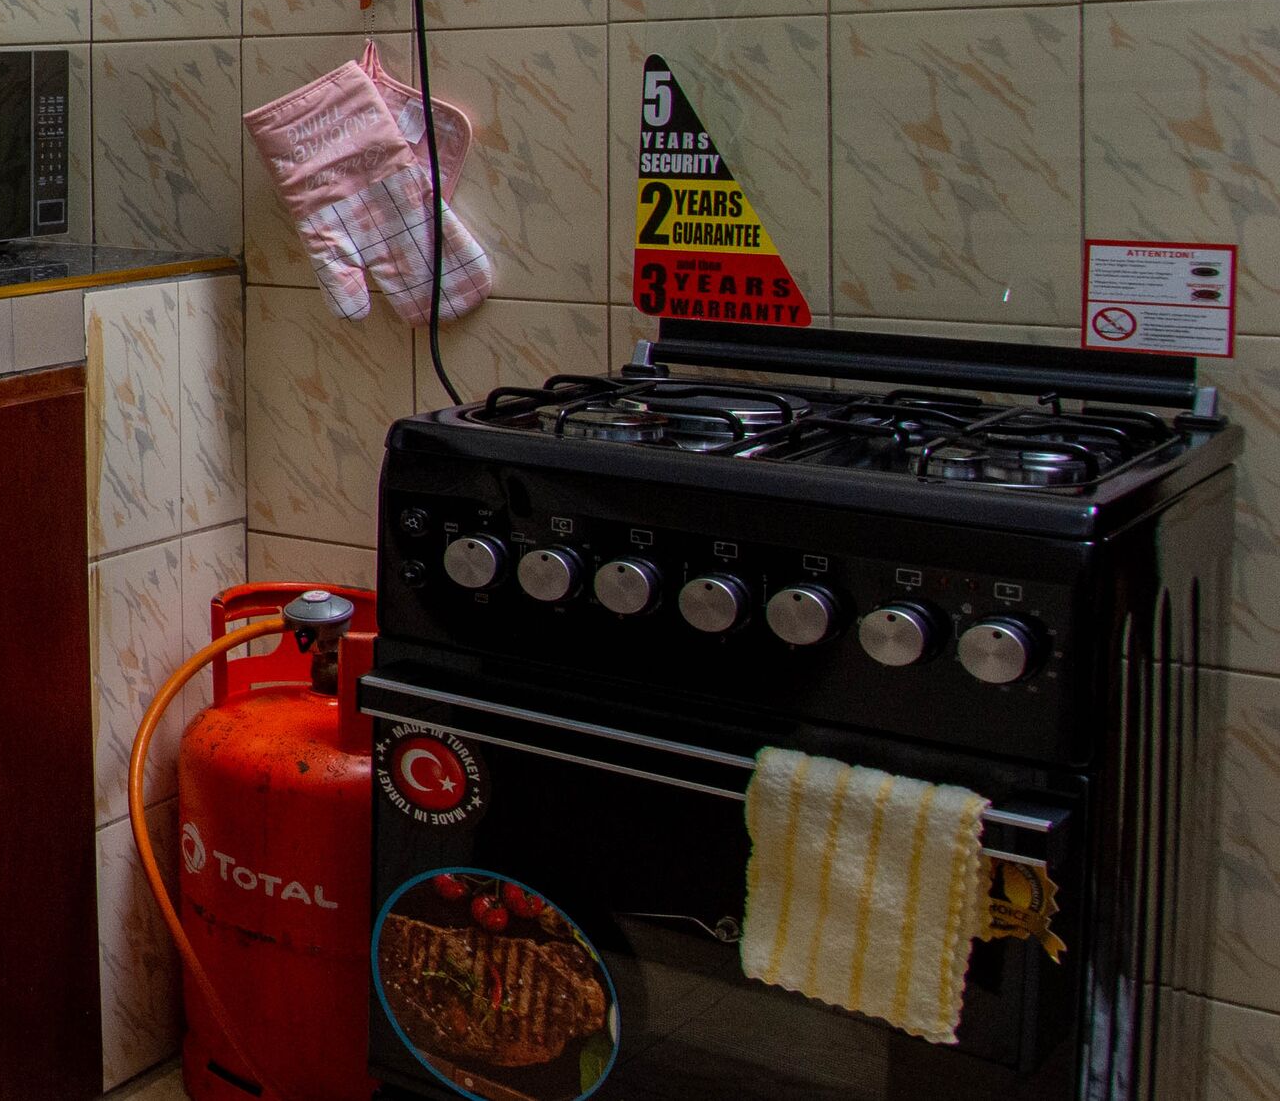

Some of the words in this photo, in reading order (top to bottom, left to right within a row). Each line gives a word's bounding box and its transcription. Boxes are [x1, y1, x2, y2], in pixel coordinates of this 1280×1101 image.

[643, 70, 672, 127] 5
[286, 105, 344, 145] THING
[642, 132, 709, 150] YEARS
[641, 153, 721, 174] SECURITY
[639, 181, 673, 246] 2
[674, 189, 743, 218] YEARS
[672, 221, 761, 248] GUARANTEE
[1126, 249, 1194, 259] ATTENTION!
[641, 263, 668, 314] 3
[675, 273, 791, 298] YEARS
[670, 299, 801, 323] WARRANTY
[446, 734, 481, 782] TURKEY
[377, 768, 412, 814] TURKEY
[414, 808, 428, 823] IN
[431, 807, 467, 825] MADE
[213, 849, 339, 910] TOTAL
